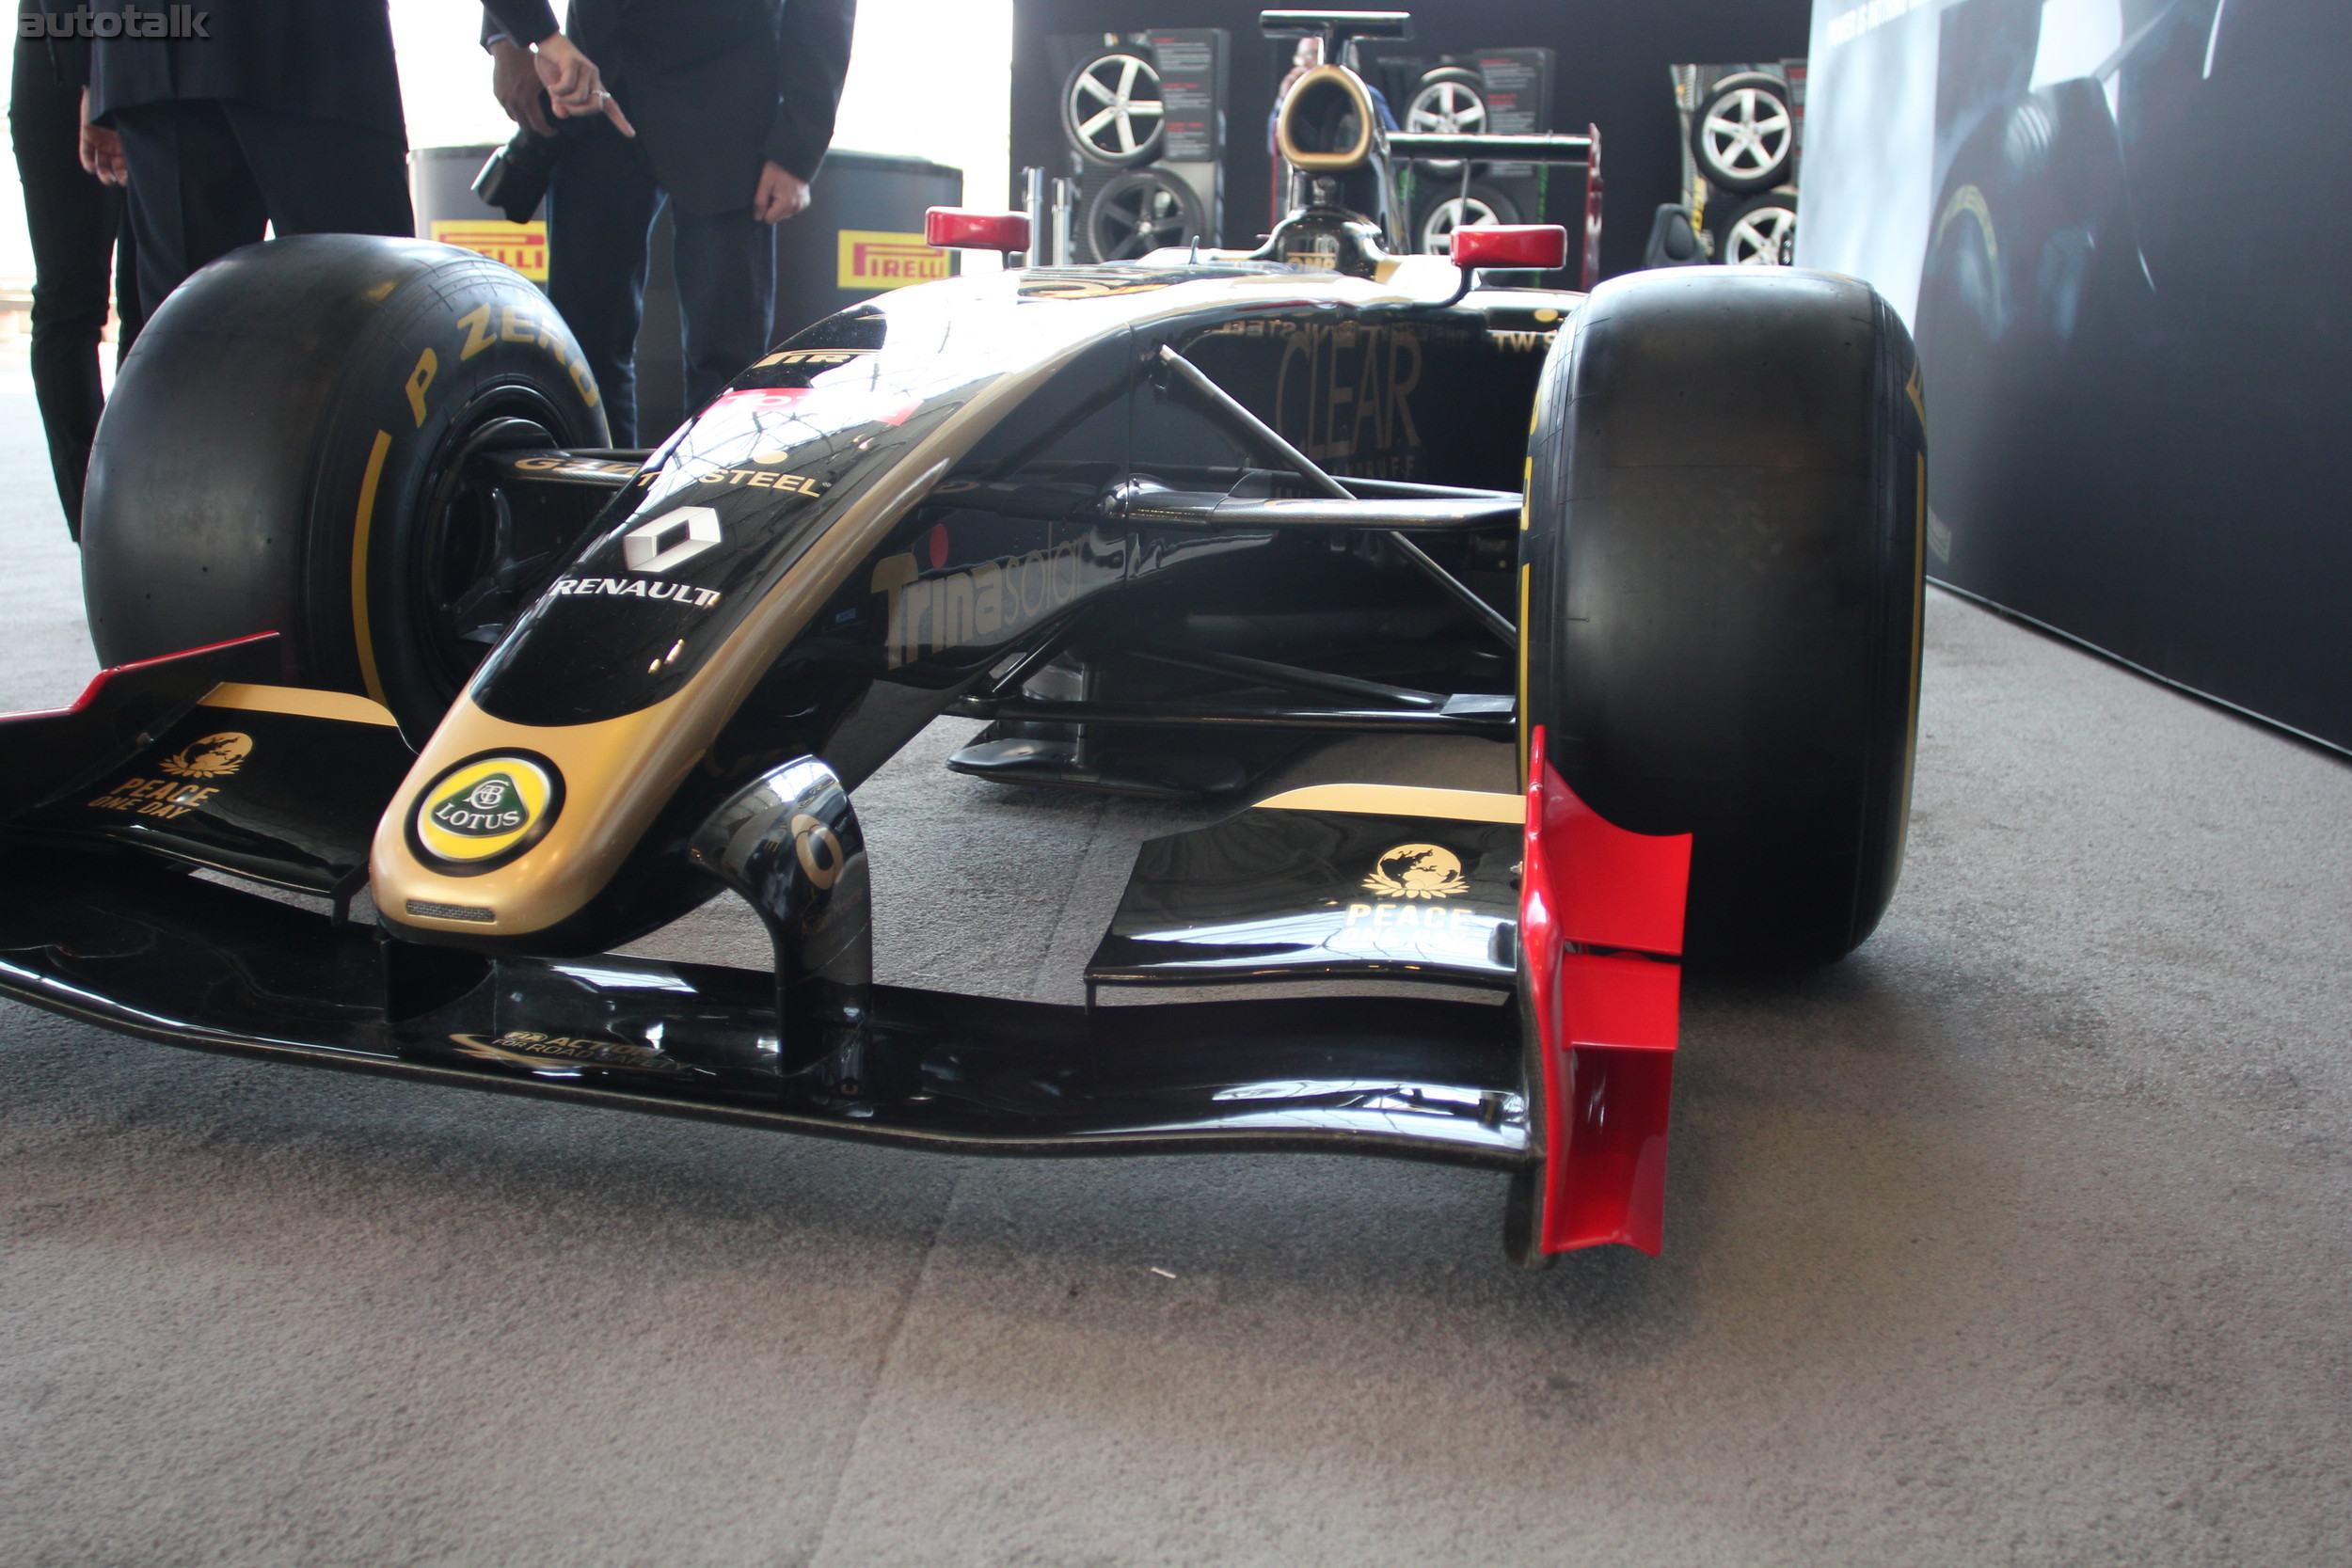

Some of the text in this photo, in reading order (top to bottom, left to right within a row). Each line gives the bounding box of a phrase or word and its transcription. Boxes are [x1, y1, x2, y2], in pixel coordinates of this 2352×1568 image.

[852, 242, 946, 278] PIRELLI
[1492, 332, 1537, 353] TW
[405, 302, 600, 429] P ZERO
[699, 469, 820, 498] STEEL
[548, 578, 722, 608] RENAULT
[110, 778, 220, 807] PEACE
[87, 796, 192, 819] ONE DAY
[435, 802, 519, 830] LOTUS
[1345, 903, 1473, 930] PEACE
[491, 1038, 528, 1049] FOR
[527, 1041, 596, 1058] ROAD
